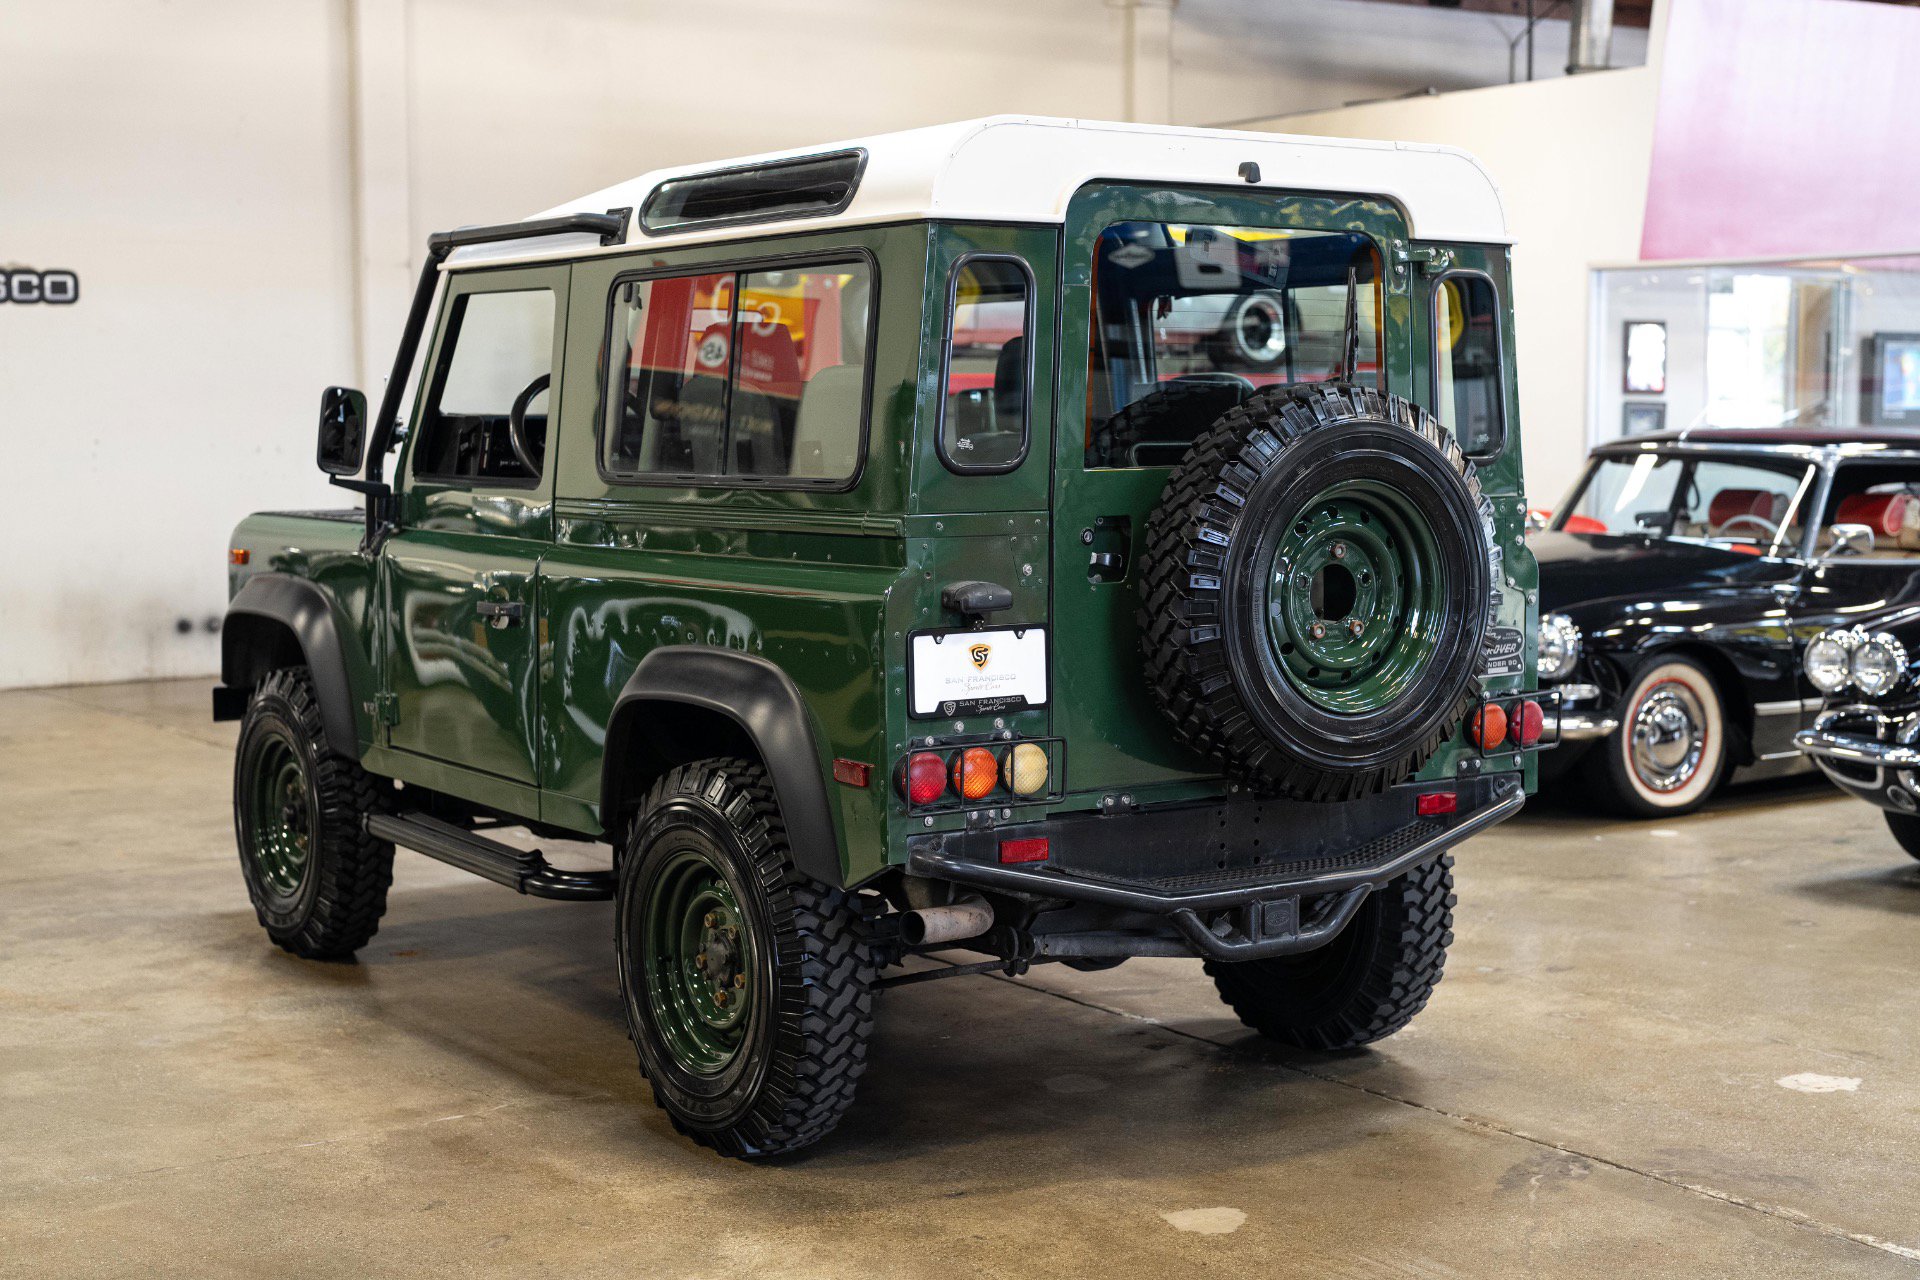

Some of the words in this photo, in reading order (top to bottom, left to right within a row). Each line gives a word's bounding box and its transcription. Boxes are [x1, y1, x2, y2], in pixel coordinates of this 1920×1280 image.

[0, 268, 79, 304] CO
[945, 677, 964, 685] SAN
[967, 673, 1017, 683] FRANCISCO
[978, 696, 1022, 706] FRANCISCO
